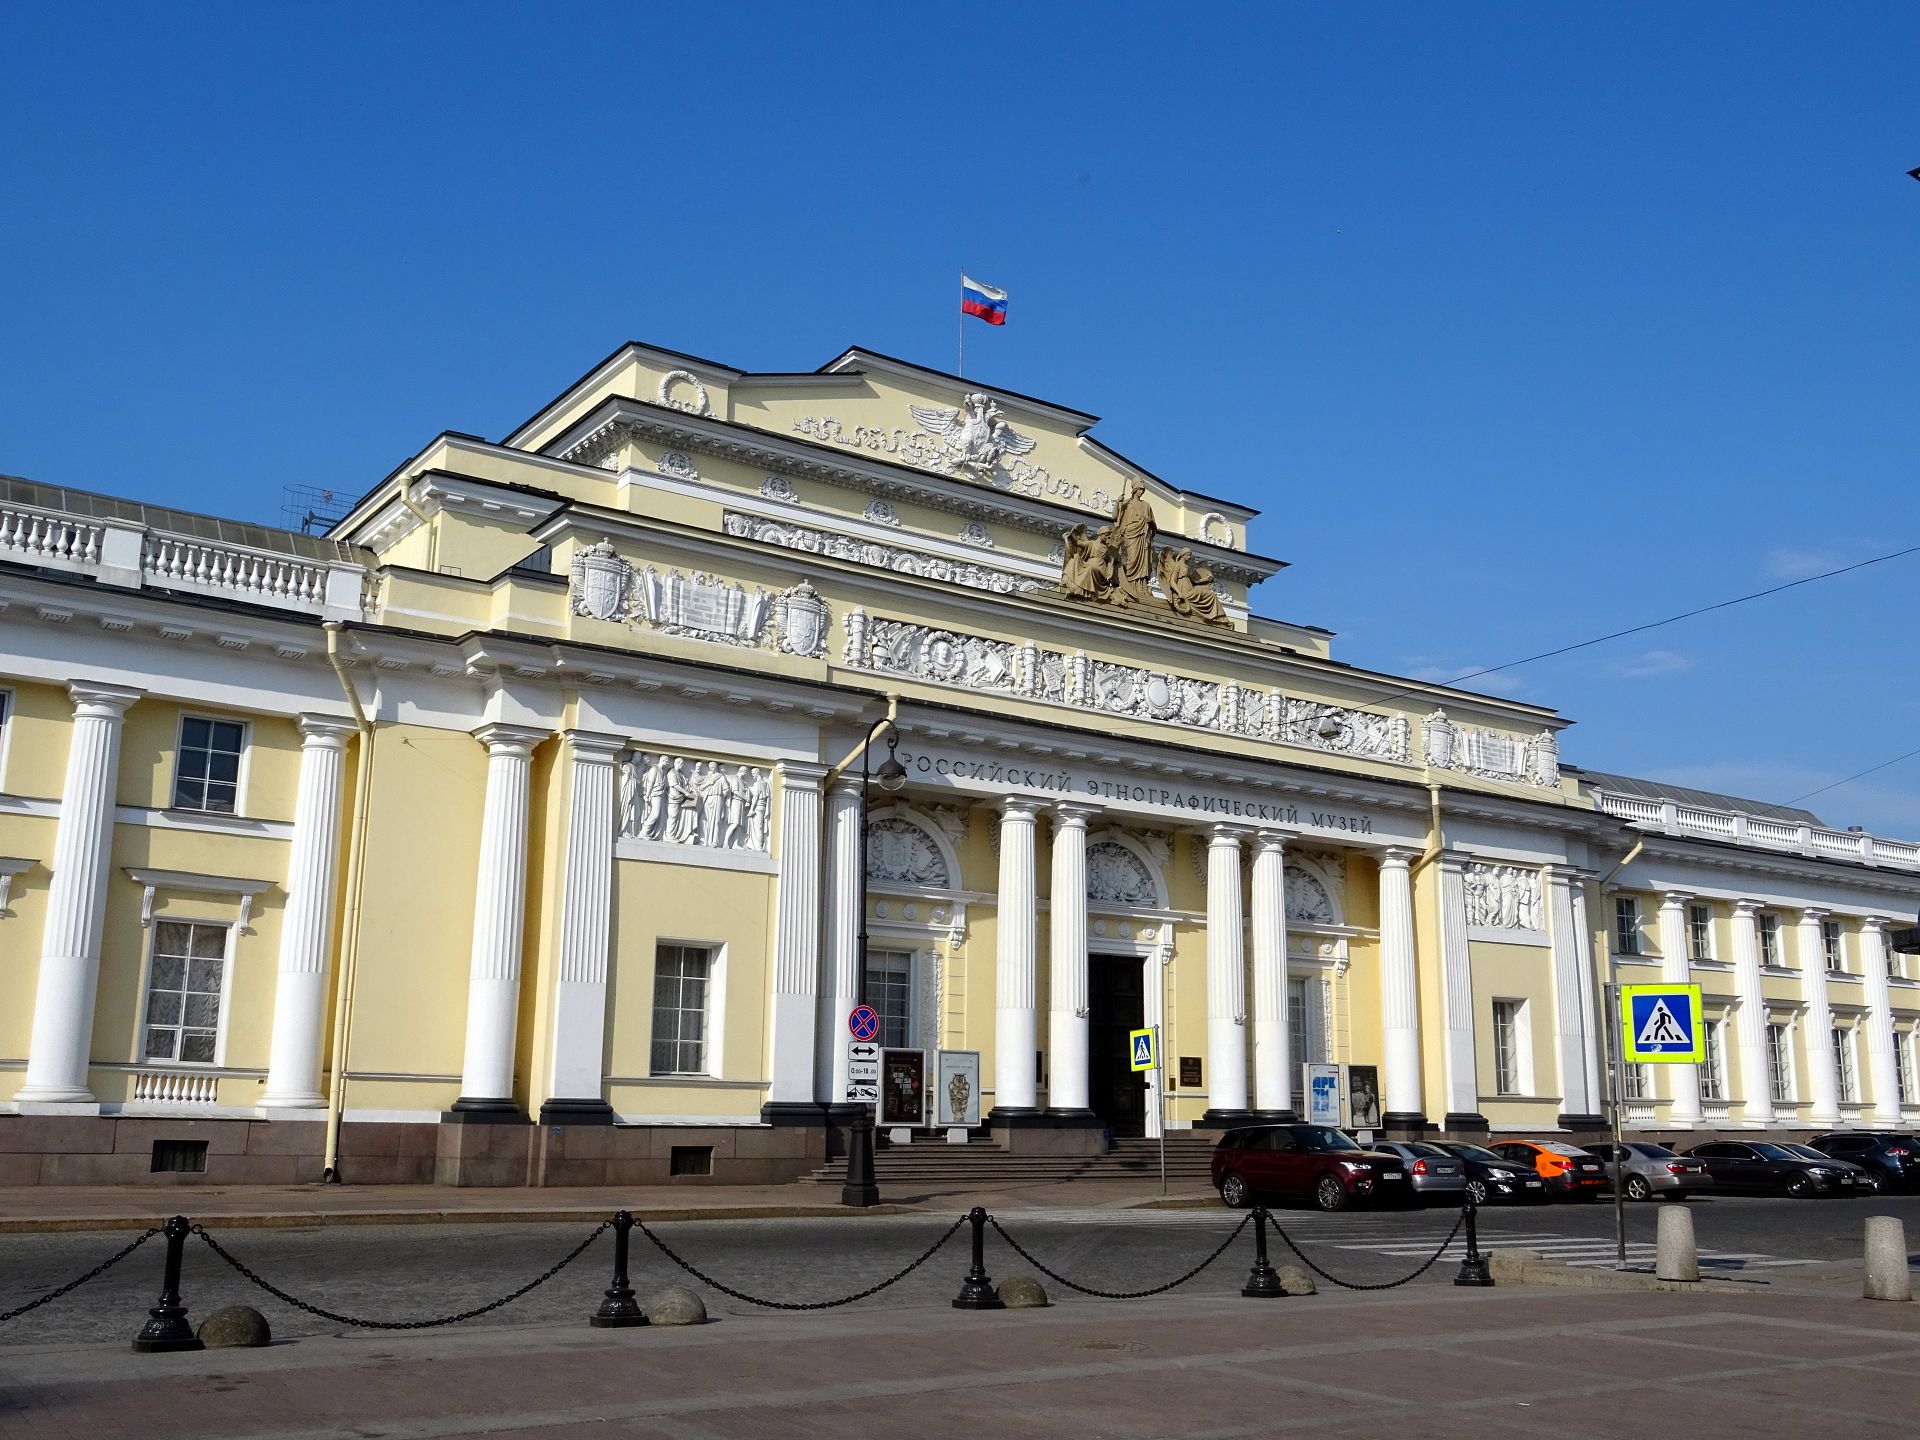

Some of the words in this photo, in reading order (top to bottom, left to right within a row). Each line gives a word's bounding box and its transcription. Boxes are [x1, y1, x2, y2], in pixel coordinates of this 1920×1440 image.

[901, 753, 1072, 793] РОССИЙСКИЙ
[1087, 780, 1300, 825] ЭТНОГРАФИЧЕСКИЙ
[1311, 812, 1373, 835] МУЗЕЙ
